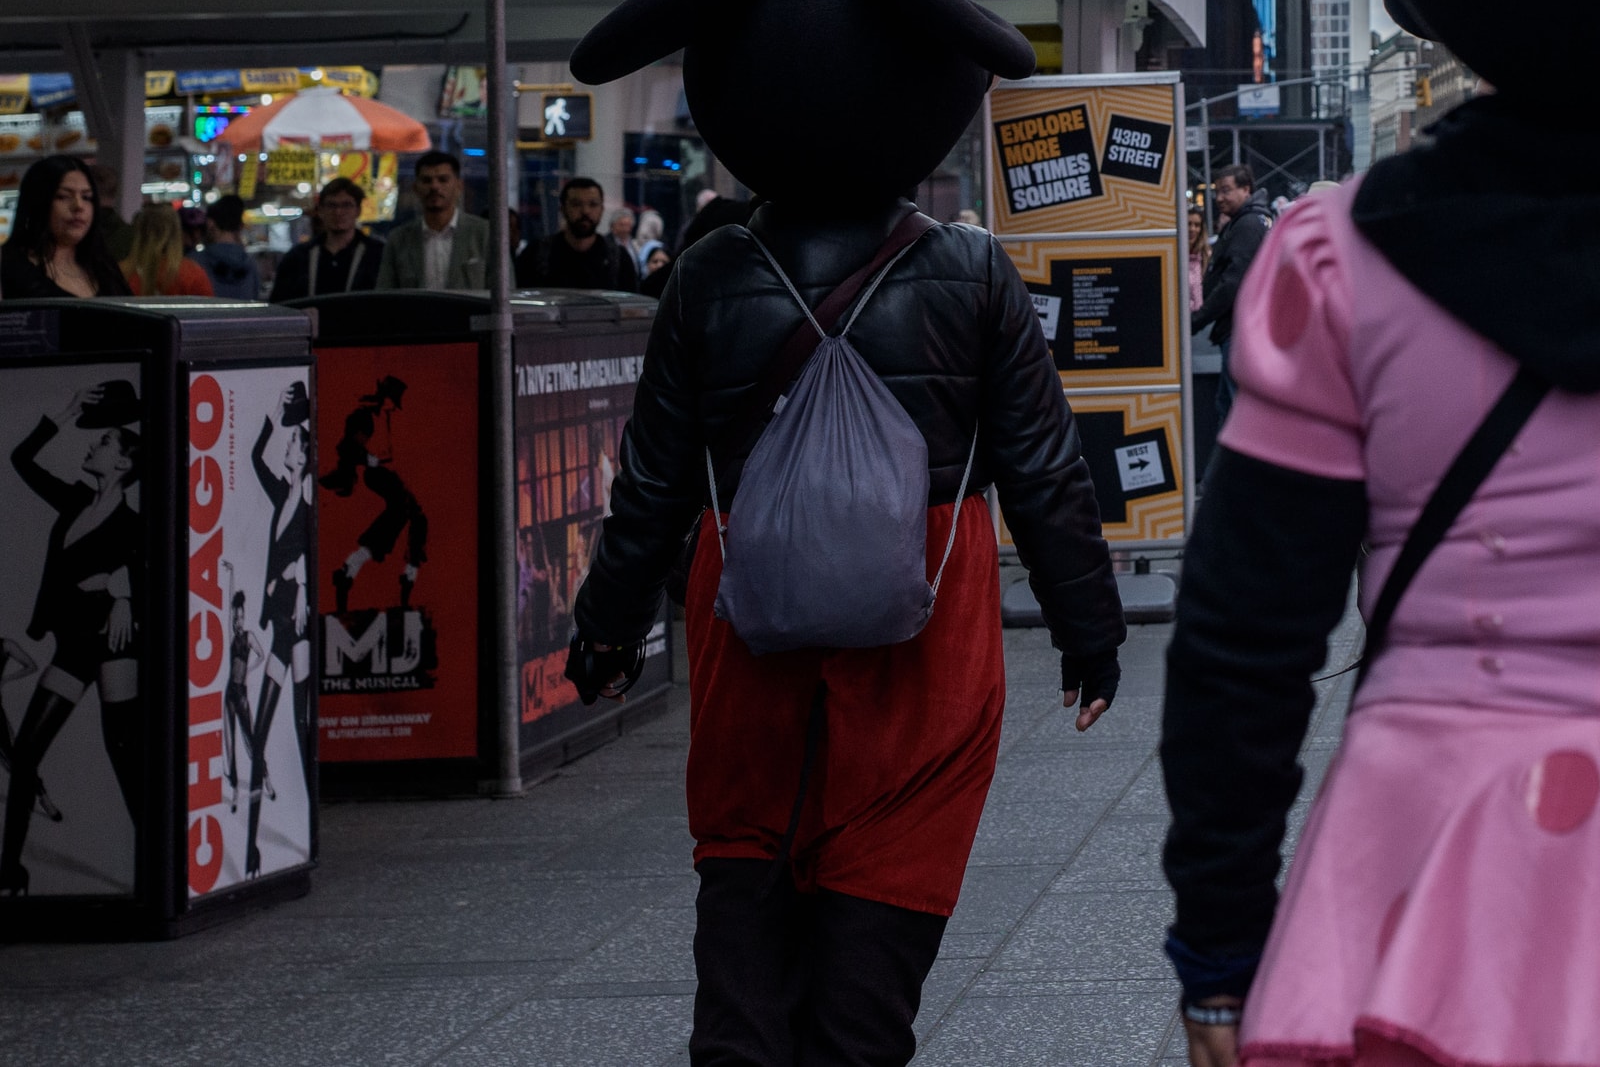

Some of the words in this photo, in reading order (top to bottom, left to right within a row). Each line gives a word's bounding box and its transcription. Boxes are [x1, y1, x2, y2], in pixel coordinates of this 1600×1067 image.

[1001, 108, 1086, 146] EXPLORE
[1112, 127, 1152, 149] 43RD
[1003, 136, 1062, 168] MORE
[1107, 147, 1163, 170] STREET
[1008, 164, 1031, 190] IN
[1032, 152, 1092, 184] TIMES
[1013, 174, 1093, 212] SQUARE
[1032, 297, 1049, 306] AST
[527, 361, 578, 396] RIVETING
[1126, 445, 1149, 457] WEST
[188, 374, 225, 895] CHICAGO
[324, 610, 424, 676] MJ
[322, 677, 351, 691] THE
[355, 676, 420, 690] MUSICAL
[318, 717, 338, 727] OW
[340, 716, 359, 726] ON
[361, 712, 432, 725] BROADWAY
